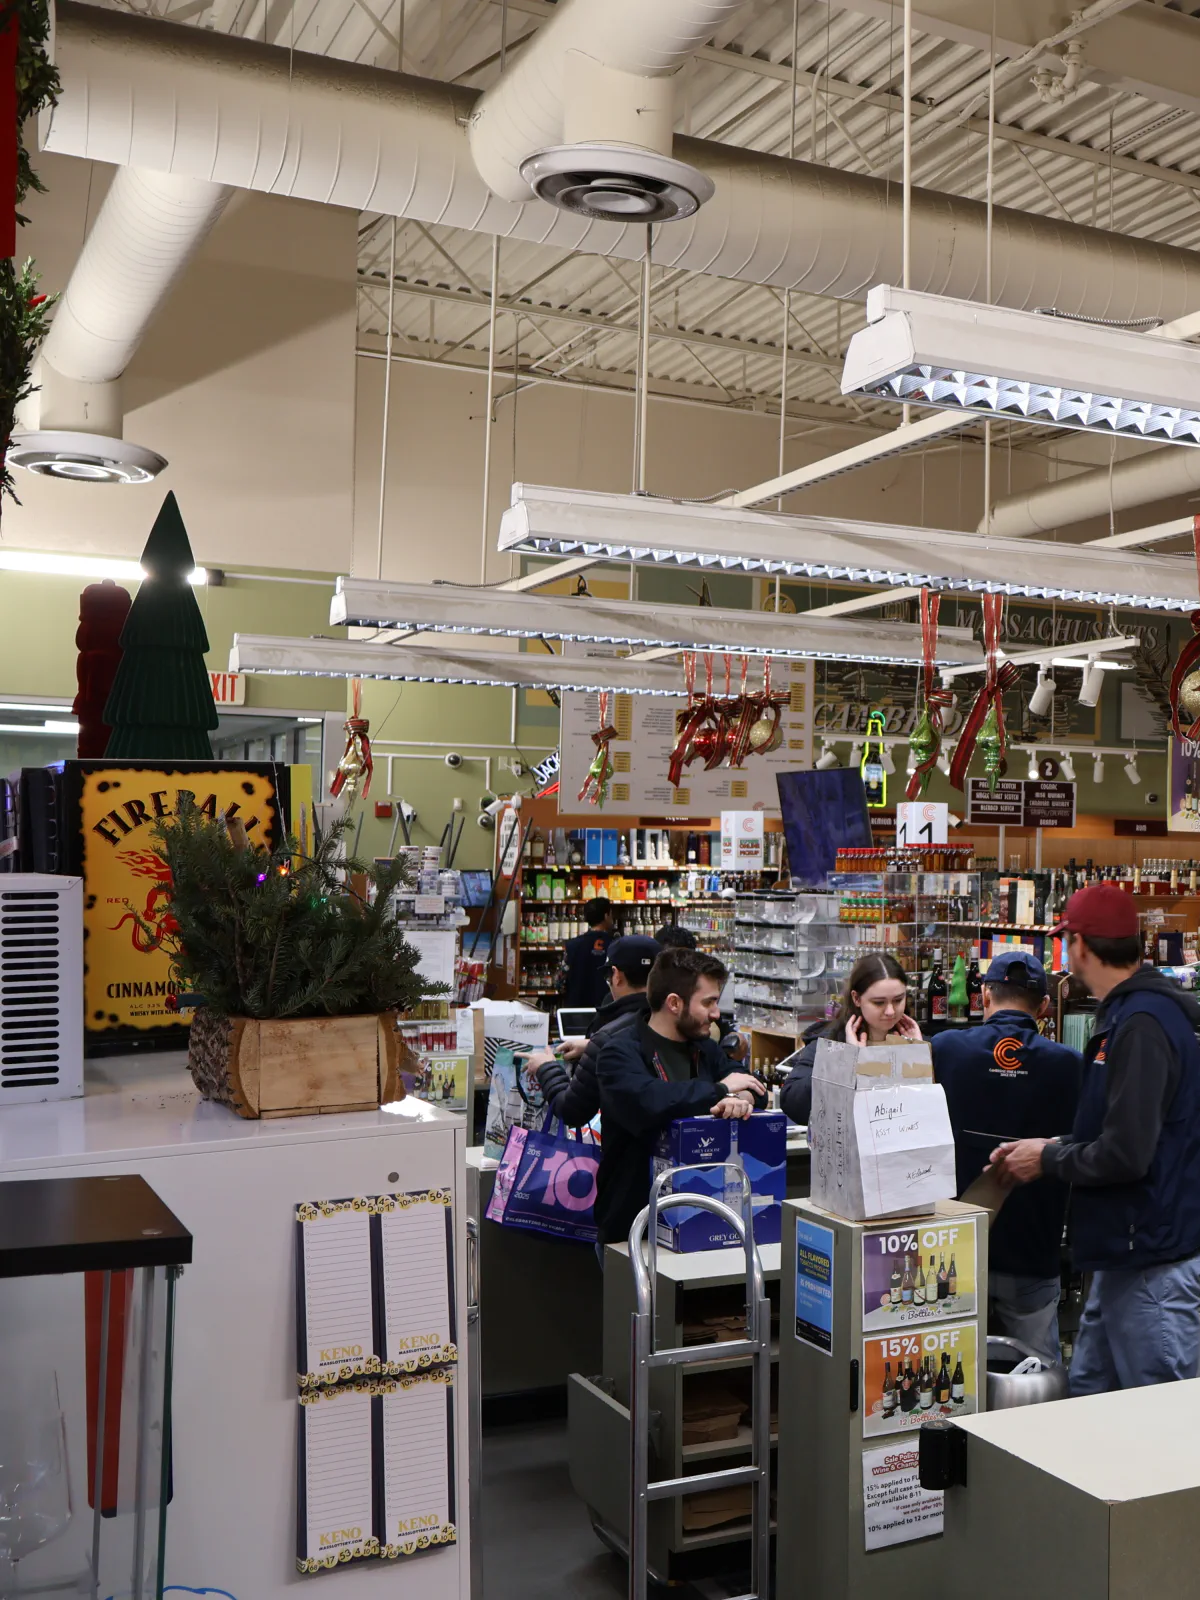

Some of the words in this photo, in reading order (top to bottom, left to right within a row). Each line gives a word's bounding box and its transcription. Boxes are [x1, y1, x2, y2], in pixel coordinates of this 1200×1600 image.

[956, 609, 1161, 649] MASACHUSTTS
[210, 674, 238, 702] XIT
[1181, 741, 1200, 758] 10%
[1045, 761, 1053, 776] 2
[871, 817, 892, 825] REMIUM
[1134, 823, 1148, 832] RUM
[899, 822, 907, 844] 1
[918, 822, 933, 844] 1
[434, 1060, 458, 1072] OFF
[874, 1102, 903, 1120] Abigail
[527, 1148, 541, 1157] 2015
[541, 1150, 600, 1212] 10
[430, 1191, 442, 1201] 56
[513, 1191, 530, 1200] 2025
[354, 1201, 367, 1209] 56
[709, 1234, 727, 1242] GREY
[878, 1232, 918, 1254] 10%
[922, 1228, 960, 1248] OFF
[908, 1307, 934, 1320] Bottles
[399, 1333, 440, 1350] KENO
[880, 1336, 920, 1358] 15%
[923, 1330, 961, 1351] OFF
[319, 1344, 363, 1362] KENO
[398, 1345, 442, 1355] MASSLOTTERY.COM
[319, 1356, 364, 1367] MASSLOTTERY.COM
[406, 1360, 415, 1370] 17
[419, 1354, 431, 1365] 53
[326, 1371, 336, 1381] 17
[340, 1366, 352, 1377] 53
[899, 1418, 908, 1426] 12
[910, 1413, 936, 1425] Bottles
[885, 1455, 898, 1464] Sale
[899, 1451, 920, 1461] Policy
[872, 1466, 890, 1476] Wine
[896, 1460, 920, 1470] Champ
[866, 1484, 880, 1492] 15%
[880, 1477, 903, 1489] applied
[866, 1490, 888, 1500] Except
[888, 1487, 899, 1496] full
[899, 1485, 913, 1493] case
[867, 1499, 881, 1508] only
[881, 1493, 908, 1505] available
[909, 1490, 922, 1499] 8-11
[398, 1514, 439, 1532] KENO
[868, 1525, 882, 1533] 10%
[882, 1518, 906, 1530] applied
[929, 1510, 944, 1518] more
[319, 1527, 362, 1546] KENO
[397, 1525, 440, 1537] MASSLOTTERY.COM
[318, 1538, 363, 1551] MASSLOTTERY.COM
